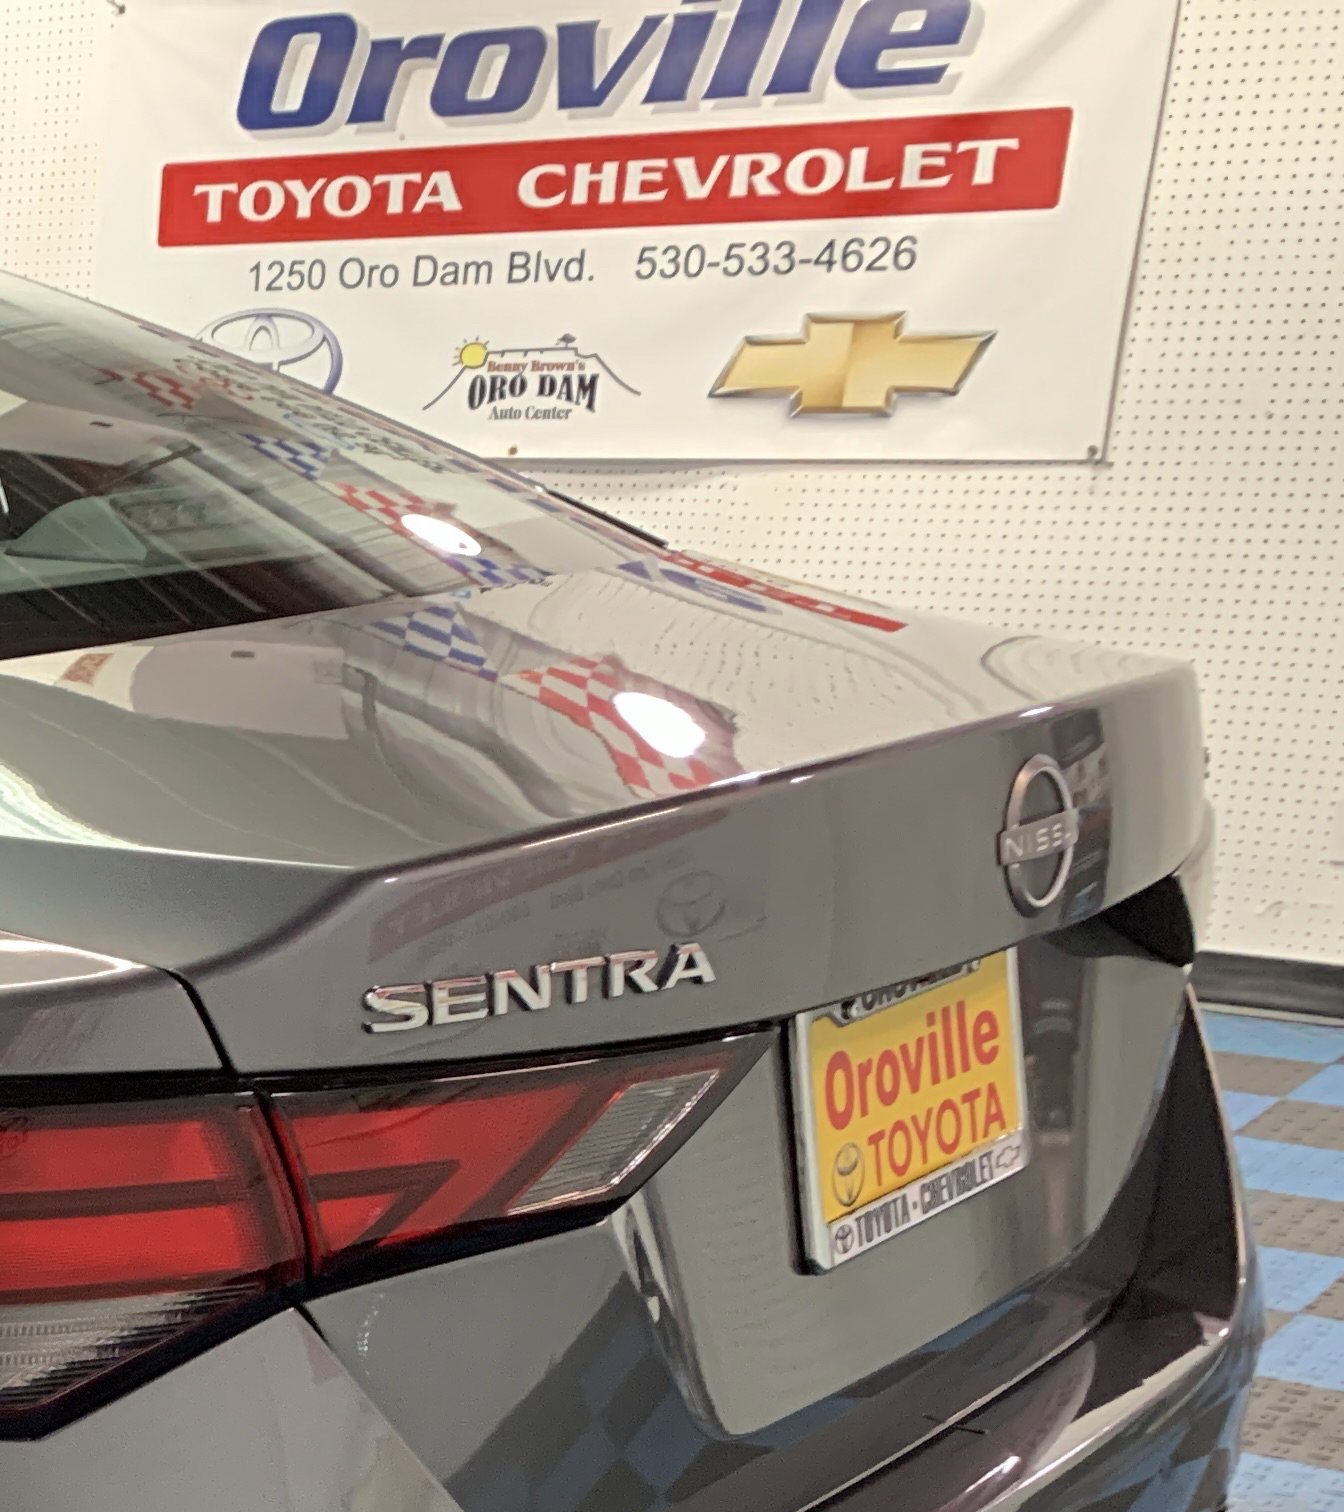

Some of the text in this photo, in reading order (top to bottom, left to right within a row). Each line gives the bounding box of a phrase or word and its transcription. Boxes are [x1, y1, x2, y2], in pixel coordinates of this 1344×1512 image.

[237, 0, 976, 134] Oroville
[194, 138, 1020, 223] TOYOTA CHEVROLET
[249, 235, 918, 292] 1250 Oro Dam Blvd. 530-533-4626
[467, 373, 600, 412] ORO DAM
[486, 359, 586, 374] Benny Brown's
[488, 405, 572, 420] Auto Center
[362, 942, 716, 1034] SENTRA
[824, 1000, 1000, 1131] Oroville
[868, 1082, 1007, 1187] TOYOTA
[855, 1151, 995, 1246] TOYOTA CHEVROLET
